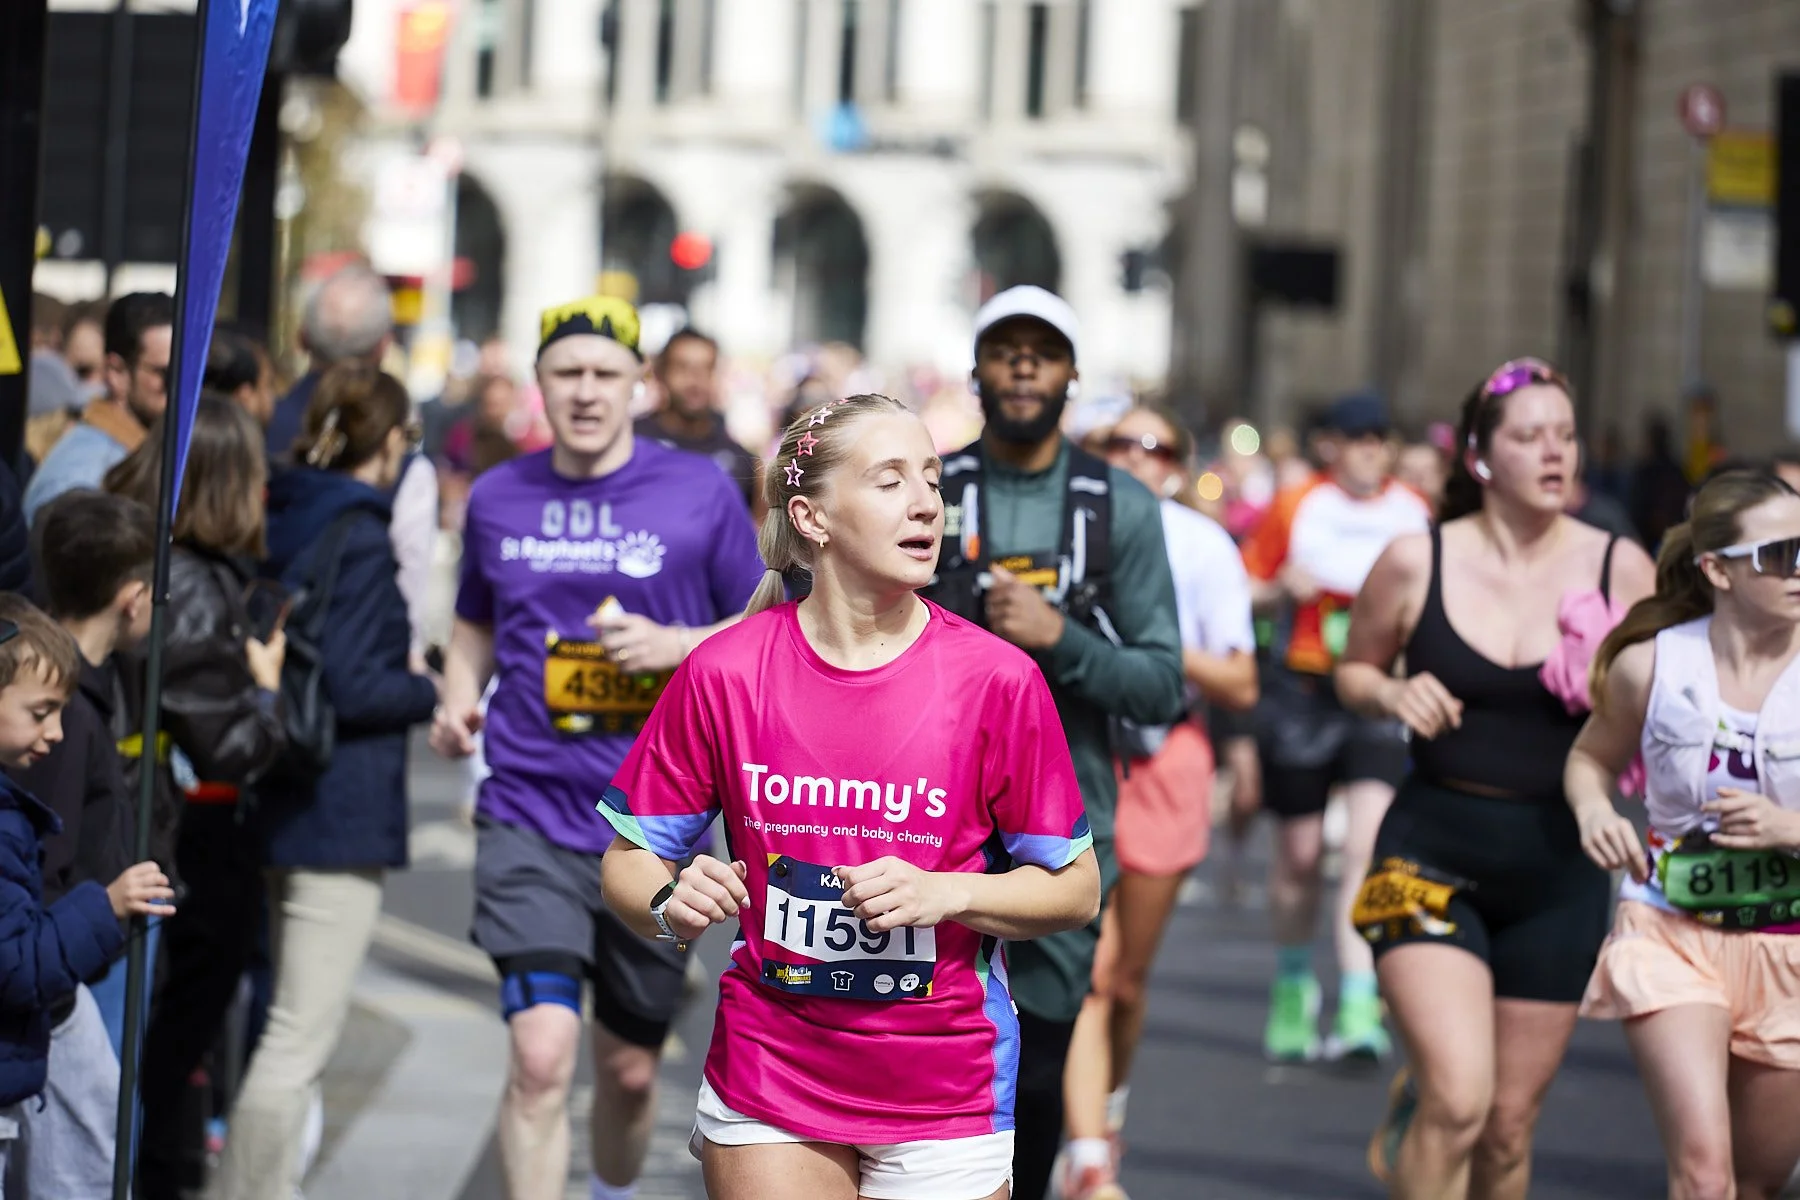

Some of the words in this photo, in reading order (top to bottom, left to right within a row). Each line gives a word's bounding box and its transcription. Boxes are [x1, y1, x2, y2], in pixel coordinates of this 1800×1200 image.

[742, 763, 948, 823] Tommy's
[744, 816, 761, 830] The
[764, 821, 829, 837] pregnancy
[833, 825, 858, 837] and
[862, 826, 894, 842] baby
[897, 831, 943, 848] charity
[820, 873, 845, 890] KA
[1689, 857, 1789, 895] 8119
[779, 898, 916, 956] 11591
